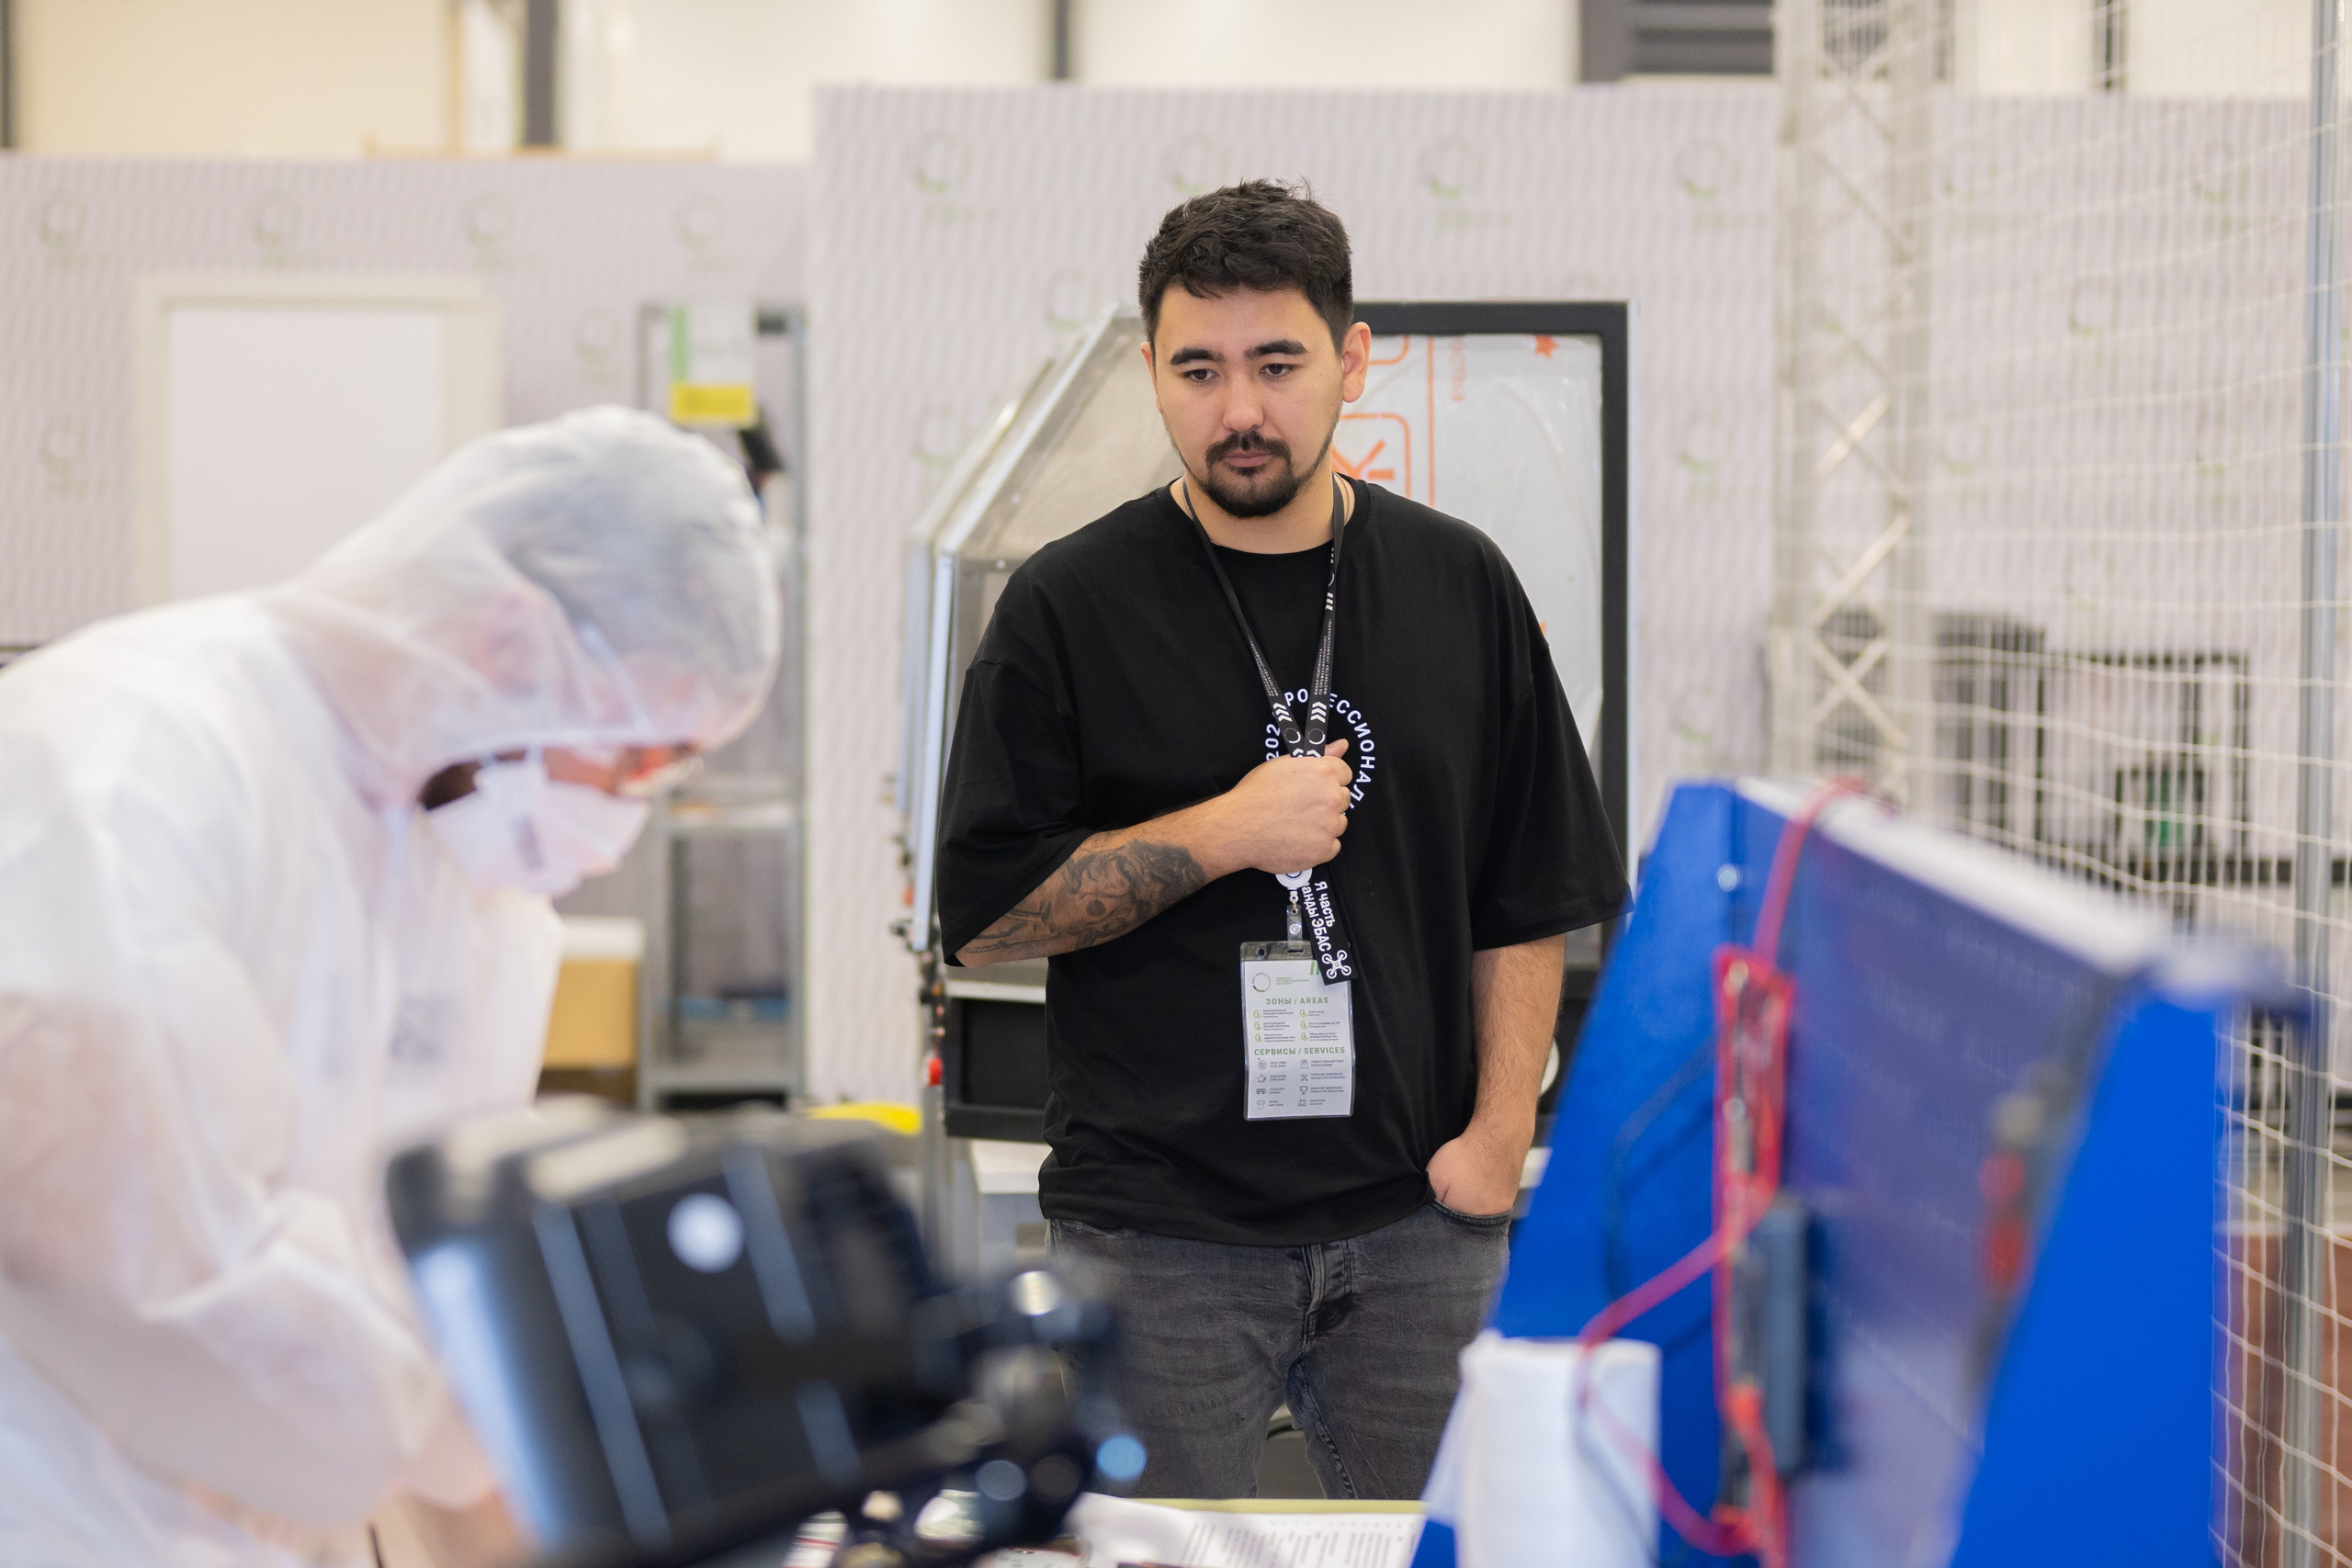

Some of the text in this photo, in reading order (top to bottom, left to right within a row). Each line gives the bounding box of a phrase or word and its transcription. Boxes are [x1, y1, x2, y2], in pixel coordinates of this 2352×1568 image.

[1265, 712, 1281, 761] 202
[1301, 882, 1332, 952] анды ЭБАС
[1314, 880, 1336, 928] Я часть
[1304, 1046, 1345, 1055] SERVICES
